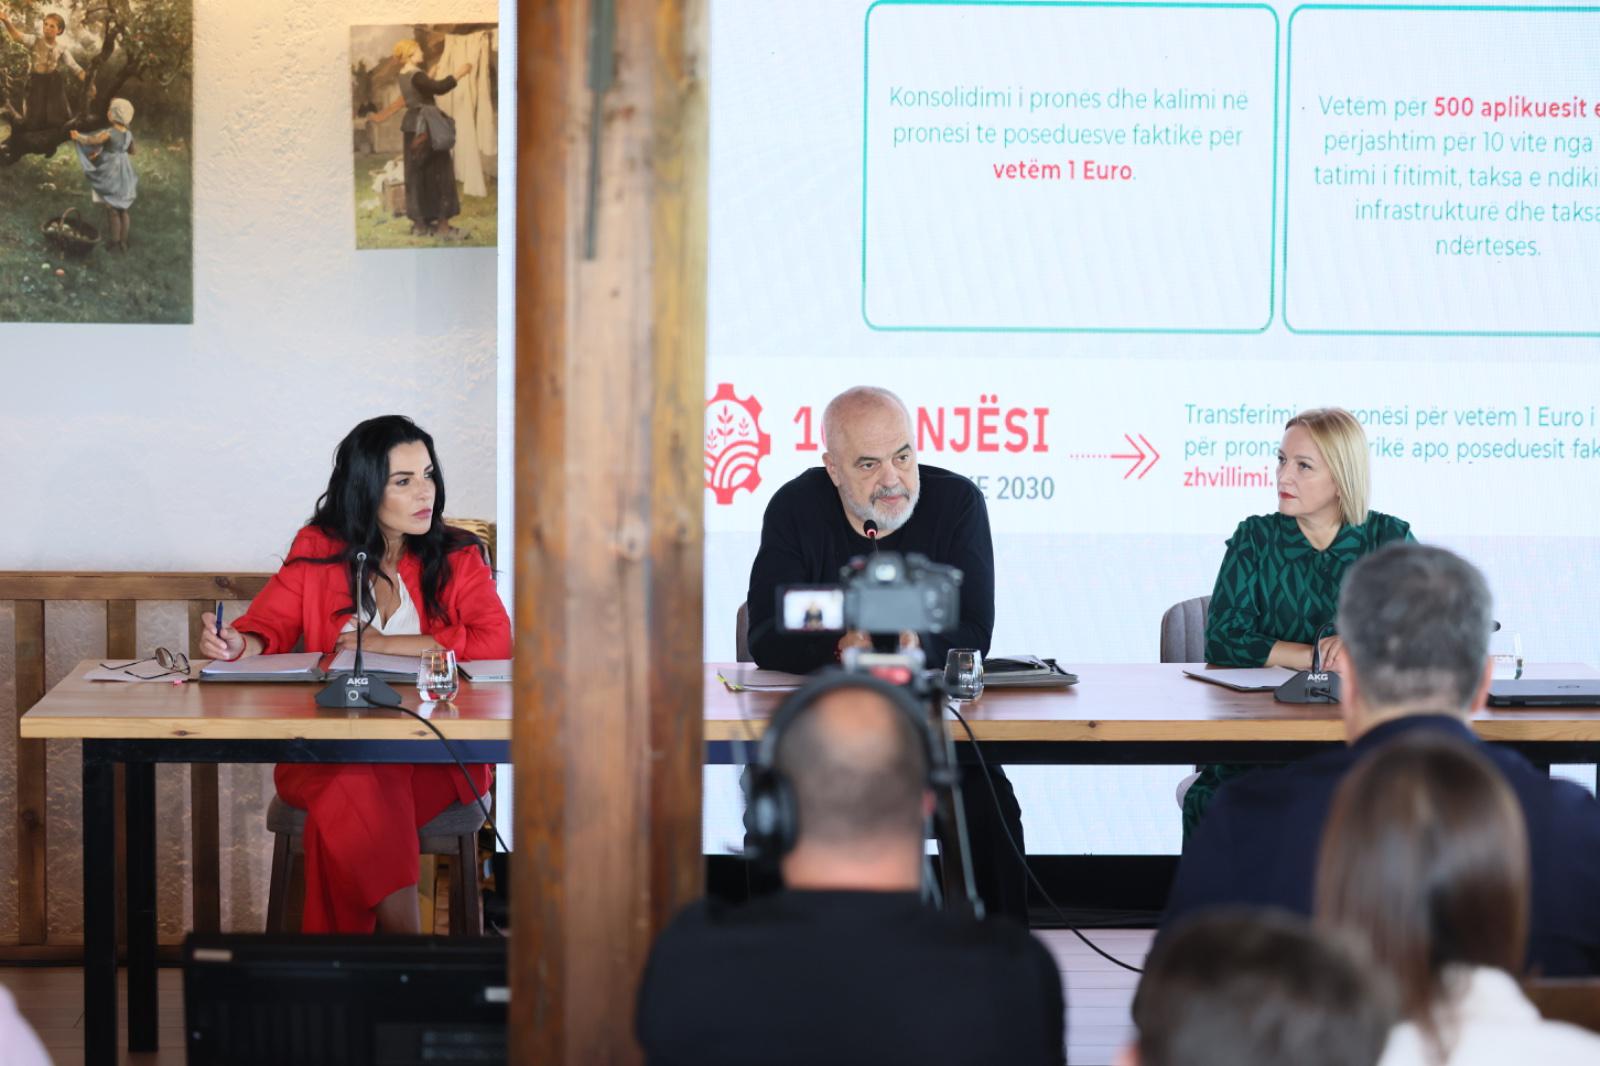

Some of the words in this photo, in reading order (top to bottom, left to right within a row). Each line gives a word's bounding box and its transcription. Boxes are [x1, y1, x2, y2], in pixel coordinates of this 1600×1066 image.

[890, 86, 1011, 108] Konsolidimi
[1018, 86, 1024, 108] i
[1107, 88, 1148, 109] dhe
[1153, 88, 1216, 110] kalimi
[1435, 97, 1473, 116] 500
[1481, 96, 1587, 121] aplikuesit
[1003, 123, 1126, 149] poseduesve
[1483, 131, 1504, 152] 10
[1510, 131, 1547, 152] vite
[1554, 136, 1592, 158] nga
[993, 160, 1060, 179] vetëm
[1067, 160, 1075, 179] 1
[1314, 164, 1375, 185] tatimi
[1394, 164, 1462, 188] fitimit,
[1468, 166, 1522, 187] taksa
[1529, 171, 1541, 187] e
[1505, 200, 1546, 222] dhe
[918, 395, 1049, 452] NJËSI
[1416, 406, 1448, 430] për
[1454, 408, 1517, 426] vetëm
[1524, 406, 1530, 426] 1
[1538, 406, 1584, 427] Euro
[1590, 406, 1595, 426] i
[1184, 436, 1217, 461] për
[1412, 442, 1448, 463] apo
[1457, 438, 1565, 464] poseduesit
[997, 476, 1054, 500] 2030
[1184, 466, 1273, 487] zhvillimi.
[346, 677, 369, 685] AKG
[1307, 673, 1329, 681] AKG
